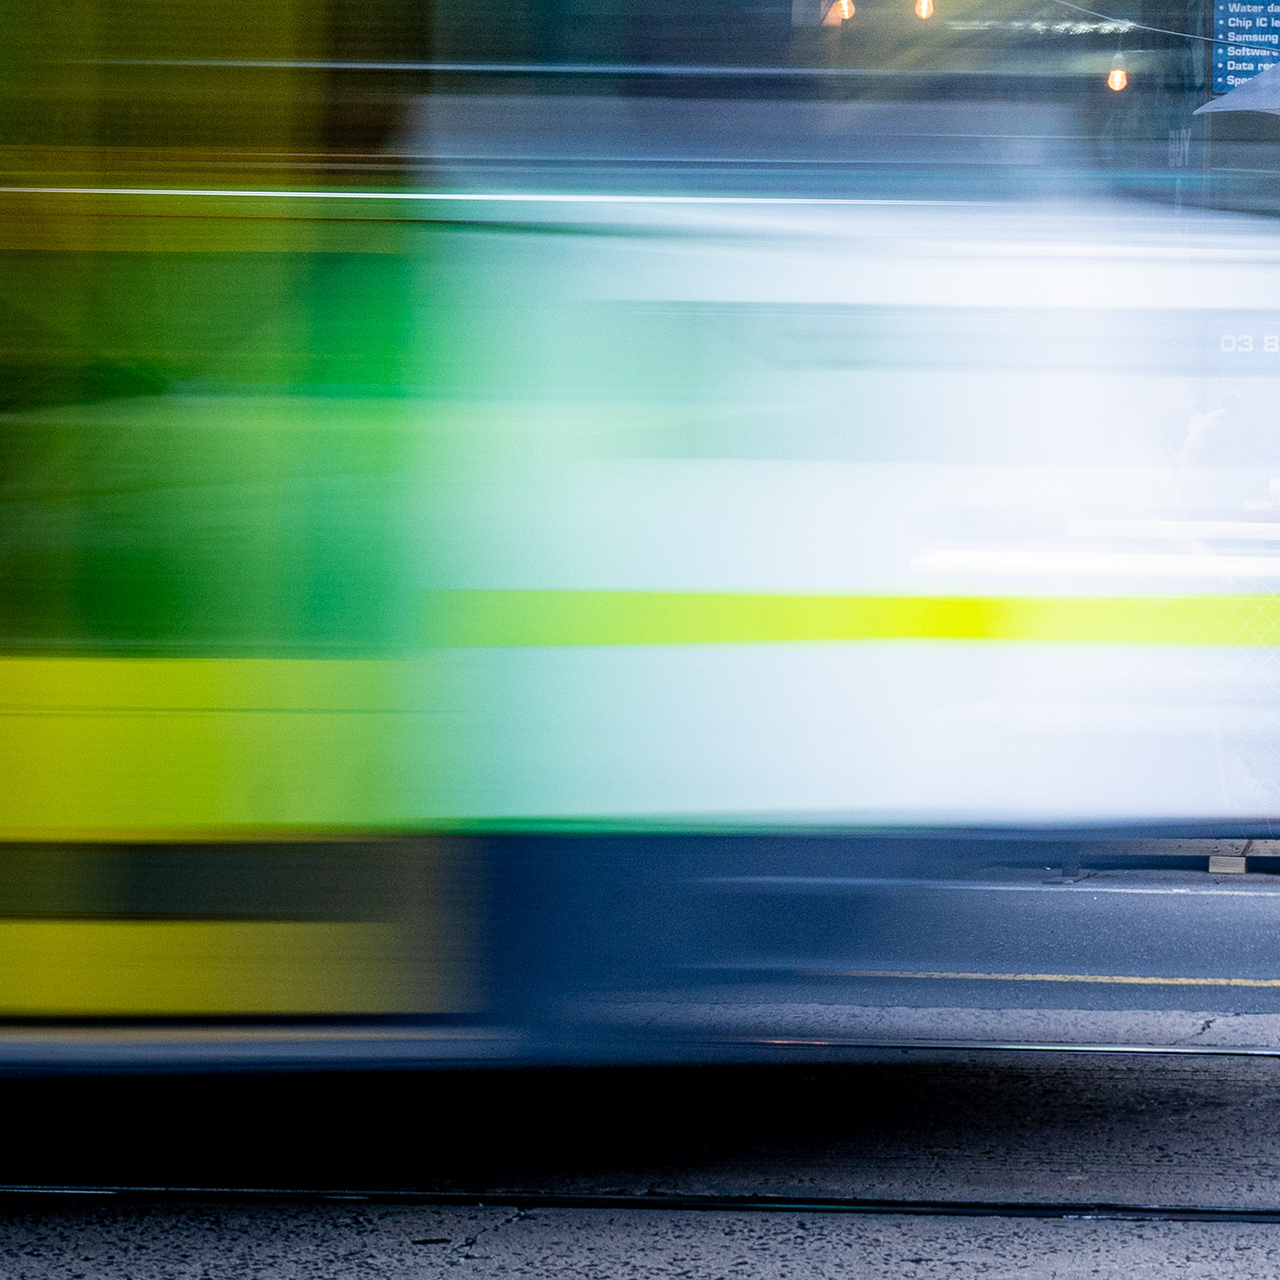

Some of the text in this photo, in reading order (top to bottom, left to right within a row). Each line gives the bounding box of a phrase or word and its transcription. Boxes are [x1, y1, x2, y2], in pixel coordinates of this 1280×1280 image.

[1228, 3, 1264, 14] Water
[1228, 18, 1252, 31] Chip
[1256, 18, 1268, 28] IC
[1227, 32, 1279, 45] Samsung
[1227, 46, 1279, 57] Software
[1227, 61, 1255, 71] Data
[1220, 334, 1254, 353] 03
